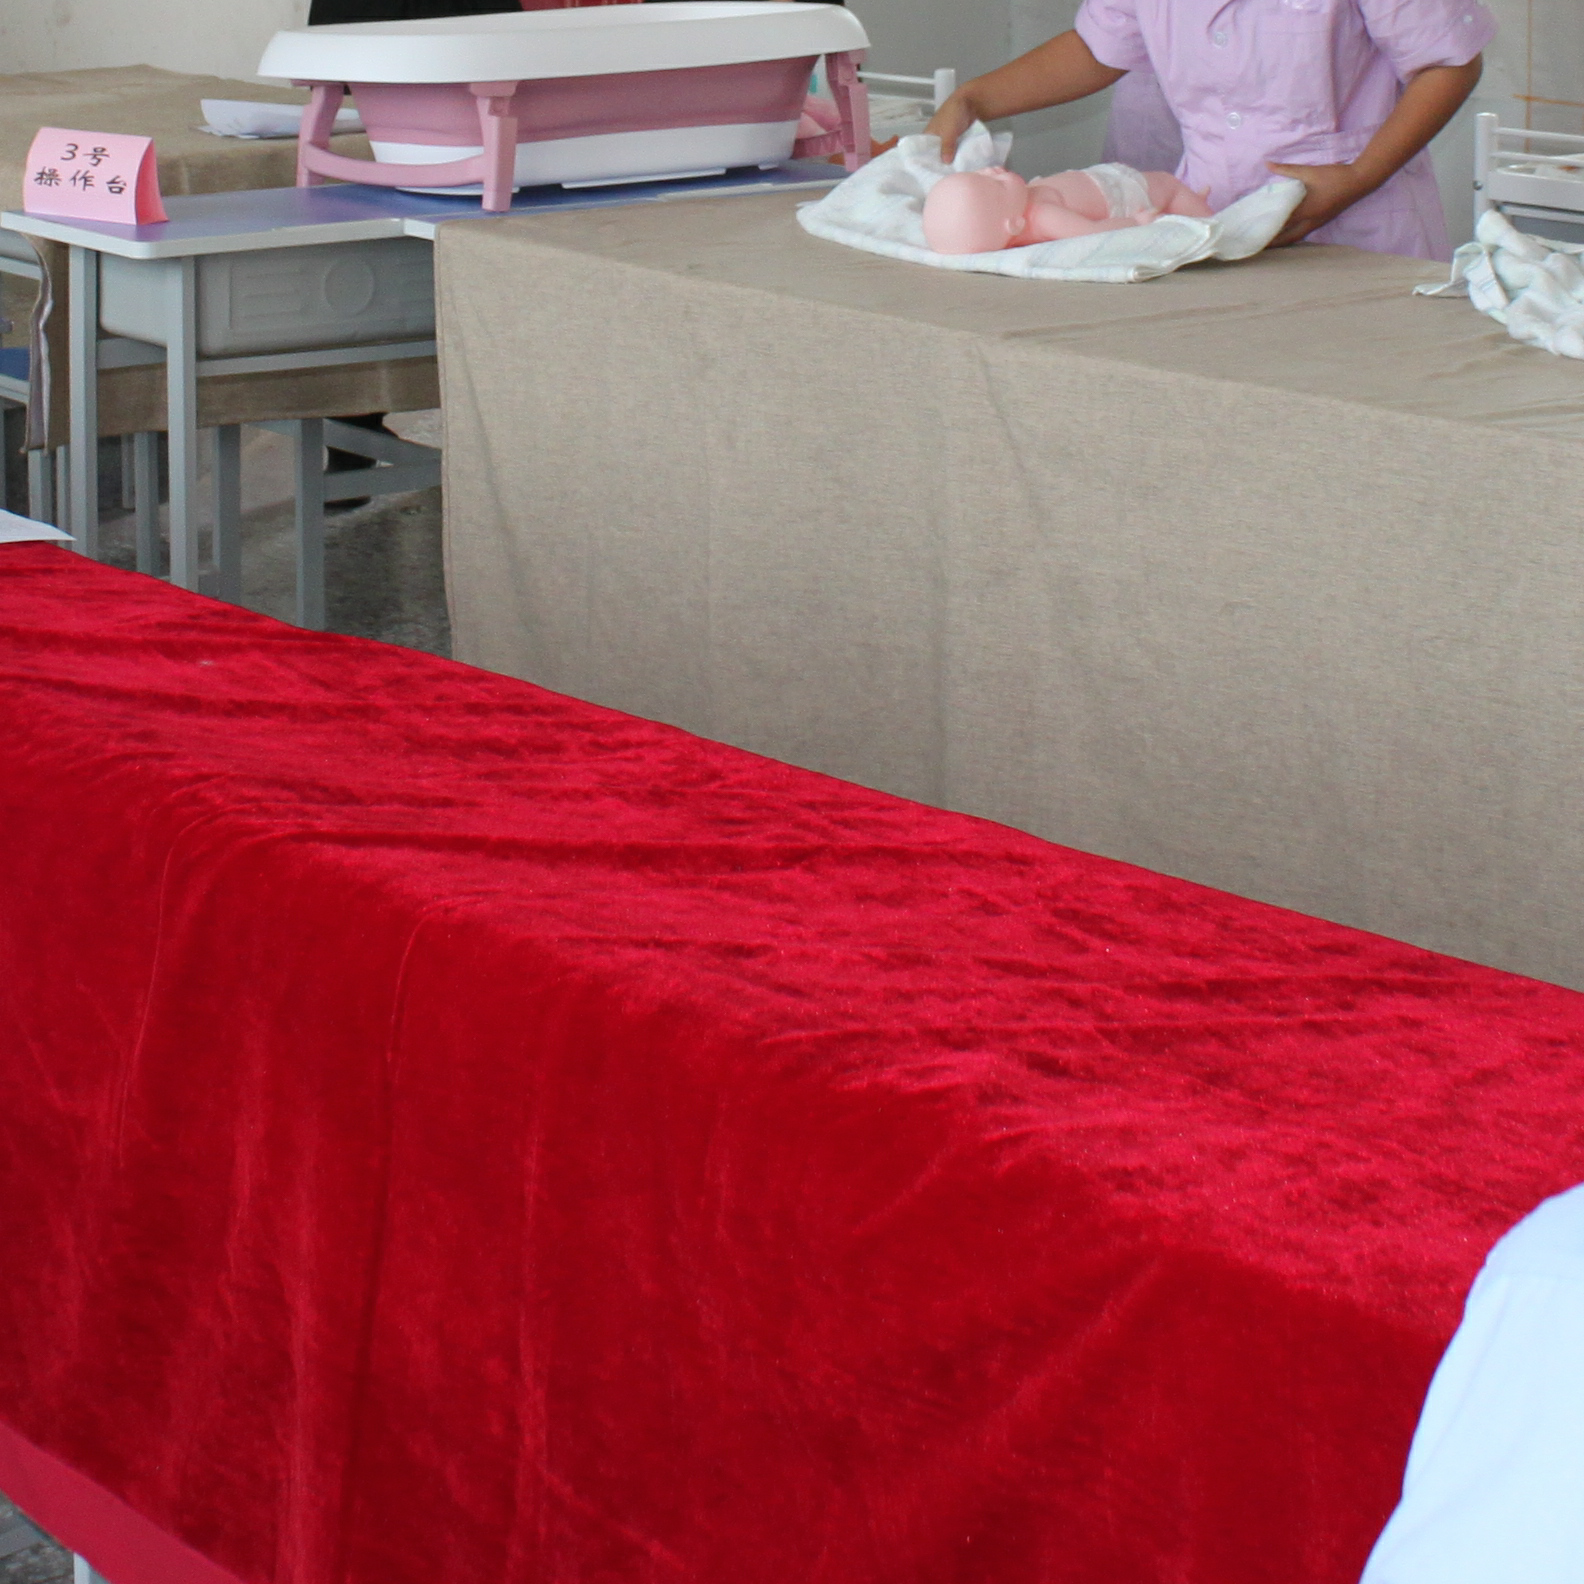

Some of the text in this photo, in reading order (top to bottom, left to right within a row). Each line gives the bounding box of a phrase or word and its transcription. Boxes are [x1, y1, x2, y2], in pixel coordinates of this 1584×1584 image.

[60, 143, 111, 168] 3号
[33, 166, 128, 196] 操作台
